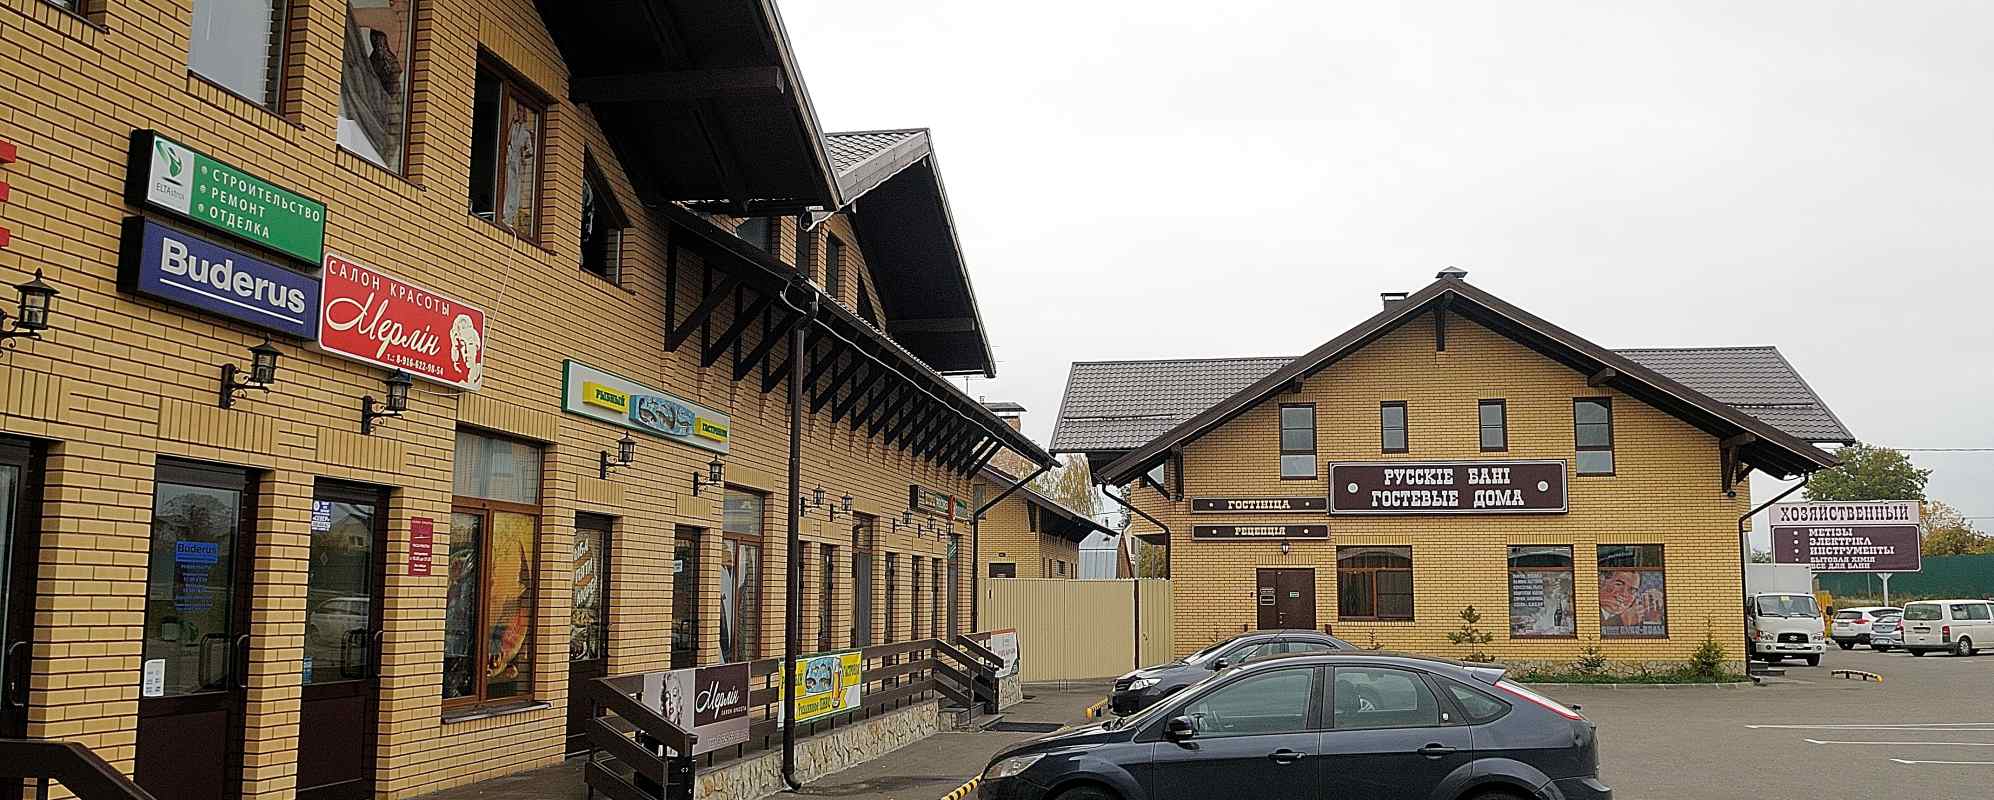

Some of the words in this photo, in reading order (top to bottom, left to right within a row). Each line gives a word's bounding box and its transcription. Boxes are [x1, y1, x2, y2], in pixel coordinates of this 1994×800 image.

[211, 187, 266, 218] РЕМОНТ
[212, 169, 320, 222] СТРОИТЕЛЬСТВО
[209, 206, 270, 239] ОТДЕЛКА
[161, 237, 305, 313] Buderus
[329, 260, 380, 291] САЛОН
[390, 284, 450, 317] КРАСОТЫ
[1384, 468, 1454, 486] РУССКІЕ
[1468, 467, 1511, 485] БАНІ
[1227, 500, 1291, 510] ГОСТІНІЦА
[1371, 490, 1459, 507] ГОСТЕВЫЕ
[1474, 489, 1525, 508] ДОМА
[1780, 504, 1909, 521] ХОЗЯЙСТВЕННЫЙ
[1235, 527, 1286, 537] РЕЦЕПЦІЯ
[1808, 528, 1853, 537] МЕТІЗЫ
[1809, 537, 1872, 546] ЭЛЕКТРІКА
[1809, 546, 1895, 555] ИНСТРУМЕНТЫ
